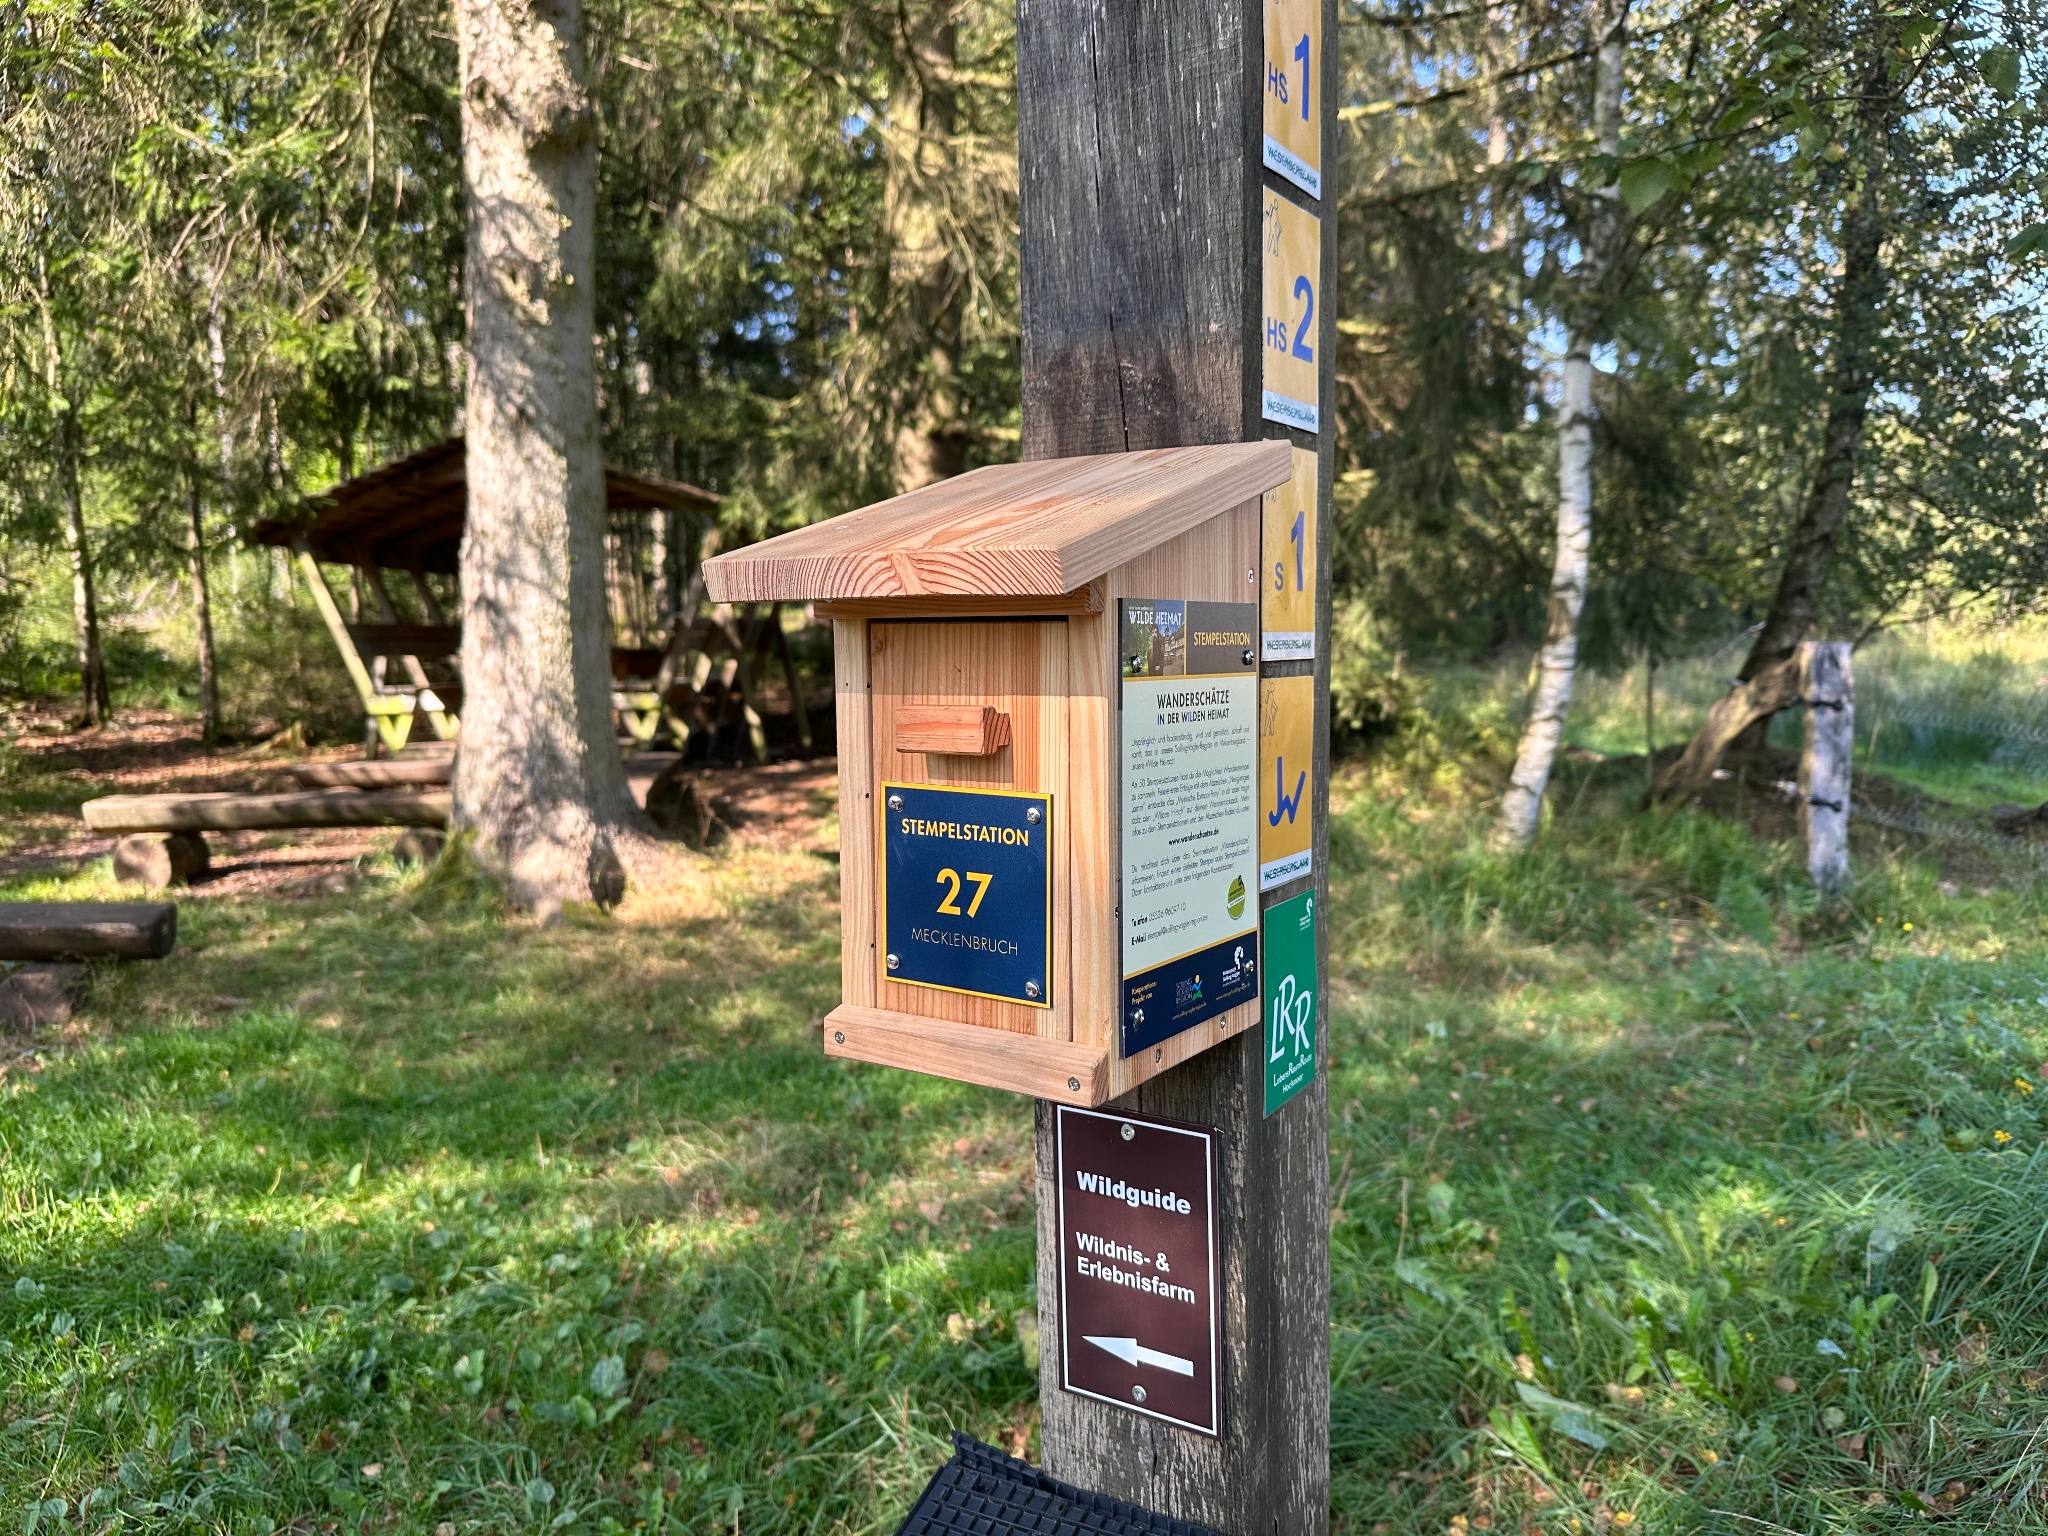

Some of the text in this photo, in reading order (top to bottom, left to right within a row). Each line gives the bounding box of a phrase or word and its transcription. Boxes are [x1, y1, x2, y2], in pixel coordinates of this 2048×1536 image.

[1268, 33, 1309, 121] HS 1
[1267, 275, 1314, 364] HS 2
[1291, 511, 1305, 592] 1
[1129, 611, 1182, 625] WILDE HEIMAT
[1193, 632, 1250, 646] STEMPELSTATION
[1157, 687, 1230, 709] WANDERSCHÄTZE
[1157, 708, 1230, 725] IN DER WILDEN HEIMAT
[901, 818, 1029, 847] STEMPELSTATION
[936, 868, 994, 919] 27
[911, 927, 1019, 957] MECKLENBRUCH
[1076, 1170, 1192, 1216] Wildguide
[1076, 1231, 1171, 1273] Wildnis- &
[1077, 1256, 1196, 1305] Erlebnisfarm
